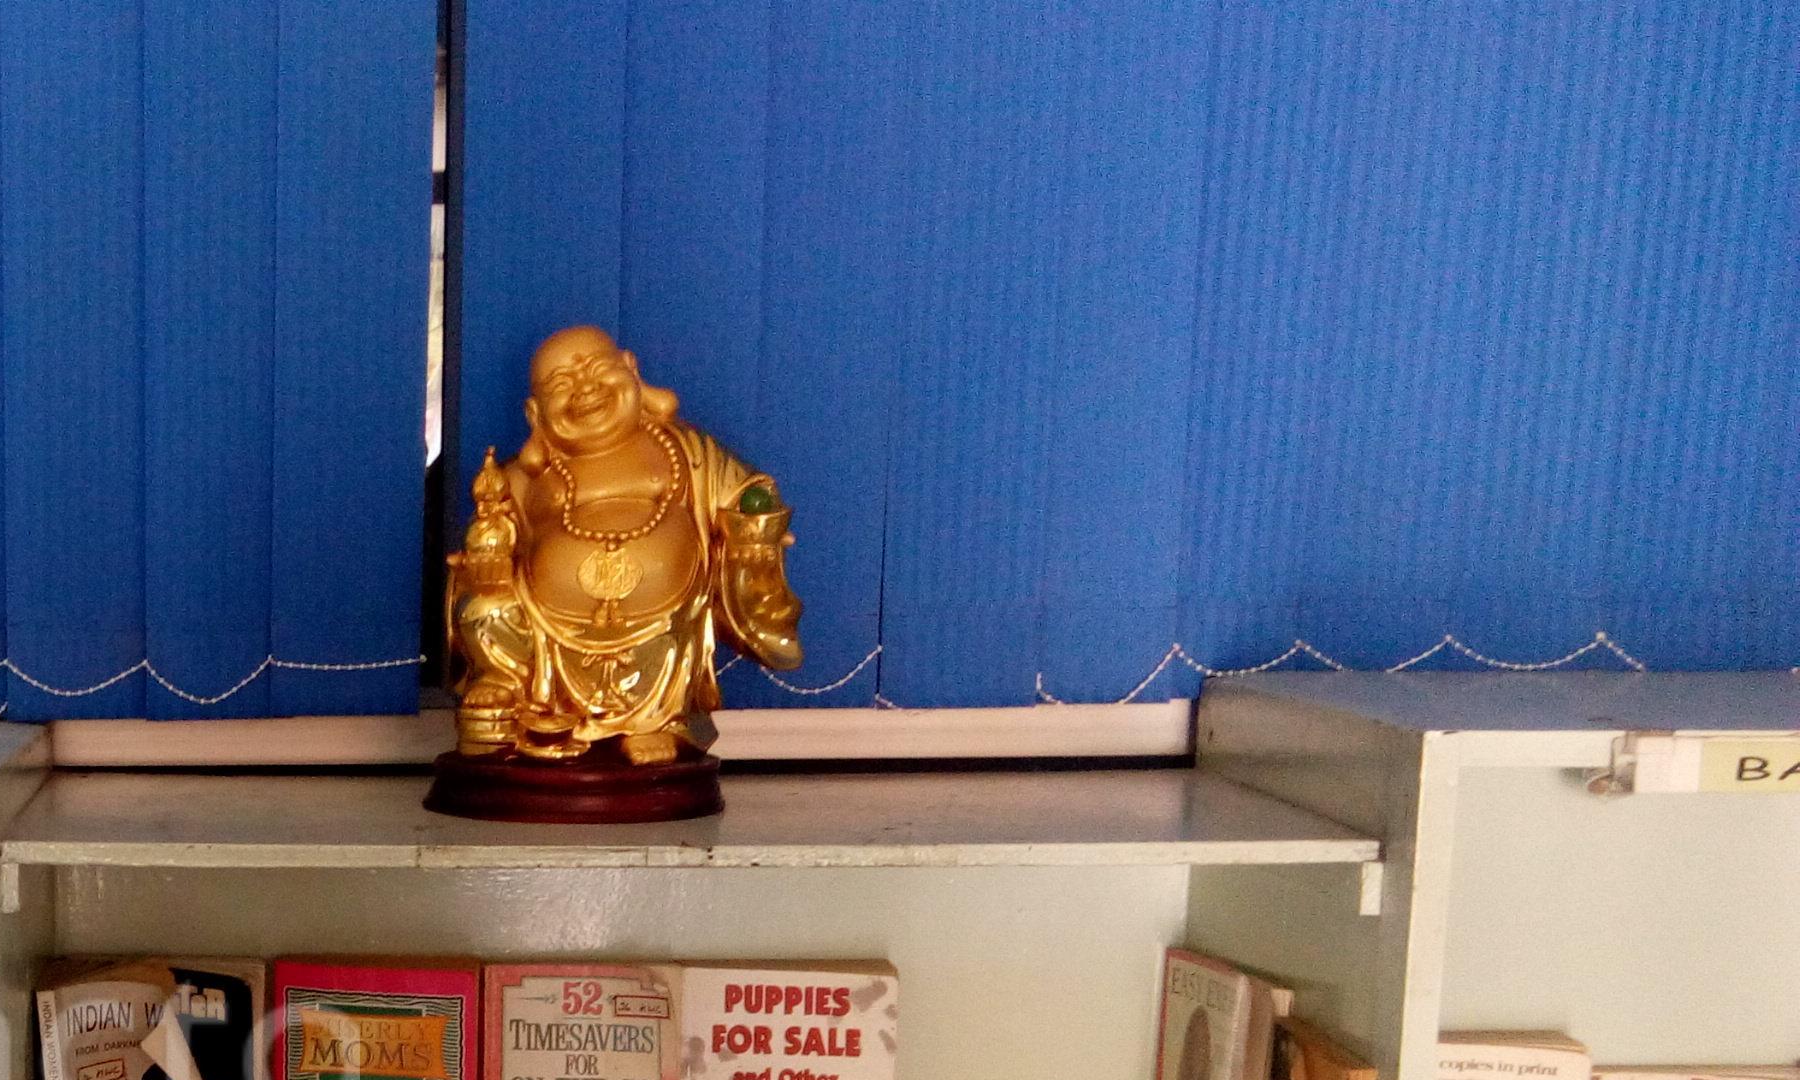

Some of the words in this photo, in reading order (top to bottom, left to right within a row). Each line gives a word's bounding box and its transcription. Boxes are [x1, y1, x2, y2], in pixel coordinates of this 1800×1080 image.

[562, 981, 604, 1016] 52
[724, 984, 852, 1018] PUPPIES
[41, 1000, 53, 1039] INDIAN
[66, 1002, 131, 1036] INDIAN
[509, 1018, 655, 1053] TIMESAVERS
[75, 1043, 100, 1057] FROM
[308, 1036, 432, 1071] MOMS
[712, 1024, 772, 1055] FOR
[784, 1027, 862, 1057] SALE
[565, 1053, 599, 1076] FOR
[1440, 1059, 1493, 1072] copies
[1498, 1060, 1514, 1072] in
[1517, 1063, 1558, 1076] print
